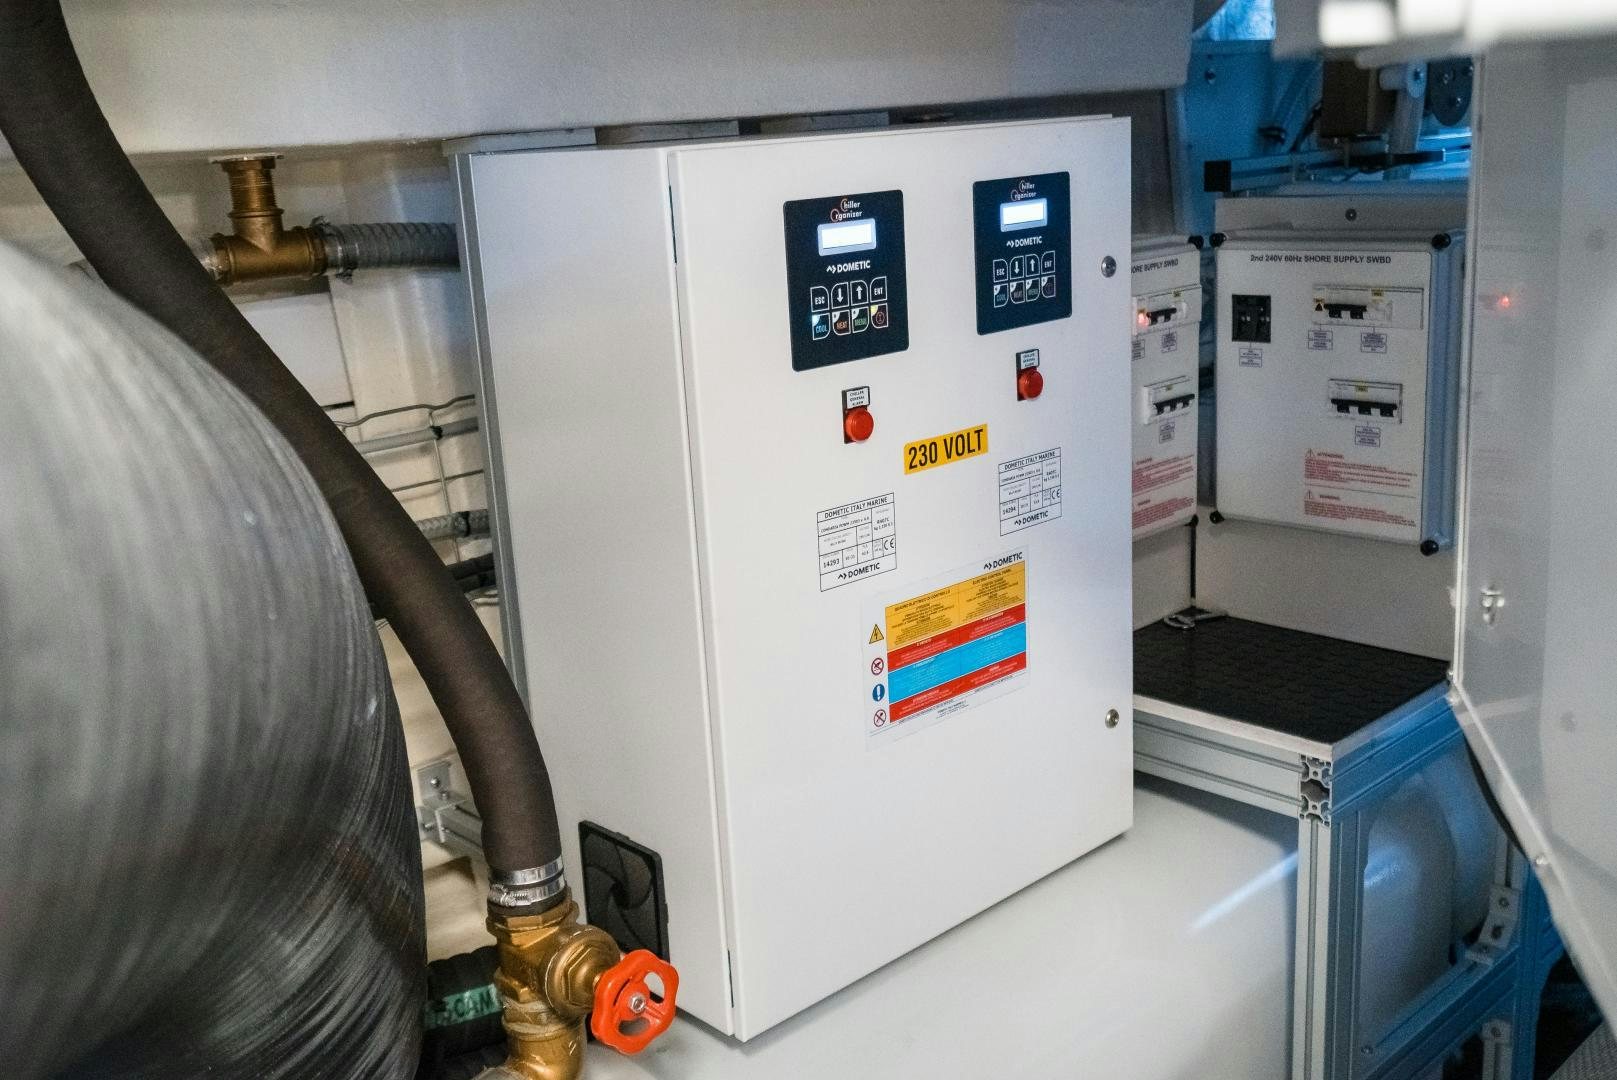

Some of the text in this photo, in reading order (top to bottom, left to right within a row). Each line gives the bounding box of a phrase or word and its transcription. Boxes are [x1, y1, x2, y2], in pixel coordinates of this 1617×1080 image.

[1019, 180, 1035, 192] Chiller
[840, 198, 860, 212] Chiller
[830, 208, 862, 222] Organizer
[1015, 236, 1042, 248] DOMETIC
[1044, 260, 1052, 268] ENT
[1144, 262, 1162, 272] SUPPLY
[1163, 258, 1178, 268] SWBD
[1304, 255, 1331, 263] SHORE
[1333, 256, 1364, 264] SUPPLY
[1366, 256, 1391, 264] SWBD
[837, 260, 871, 273] DOMETIC
[996, 268, 1005, 276] ESC
[874, 287, 883, 296] ENT
[815, 296, 825, 305] ESC
[908, 428, 983, 470] 230 VOLT
[1004, 451, 1055, 471] DOMETIC ITALY MARINE
[824, 496, 888, 519] DOMETIC ITALY MARINE
[1022, 510, 1049, 525] DOMETIC
[823, 558, 840, 569] 14293
[993, 551, 1023, 569] DOMETIC
[848, 563, 880, 578] DOMETIC
